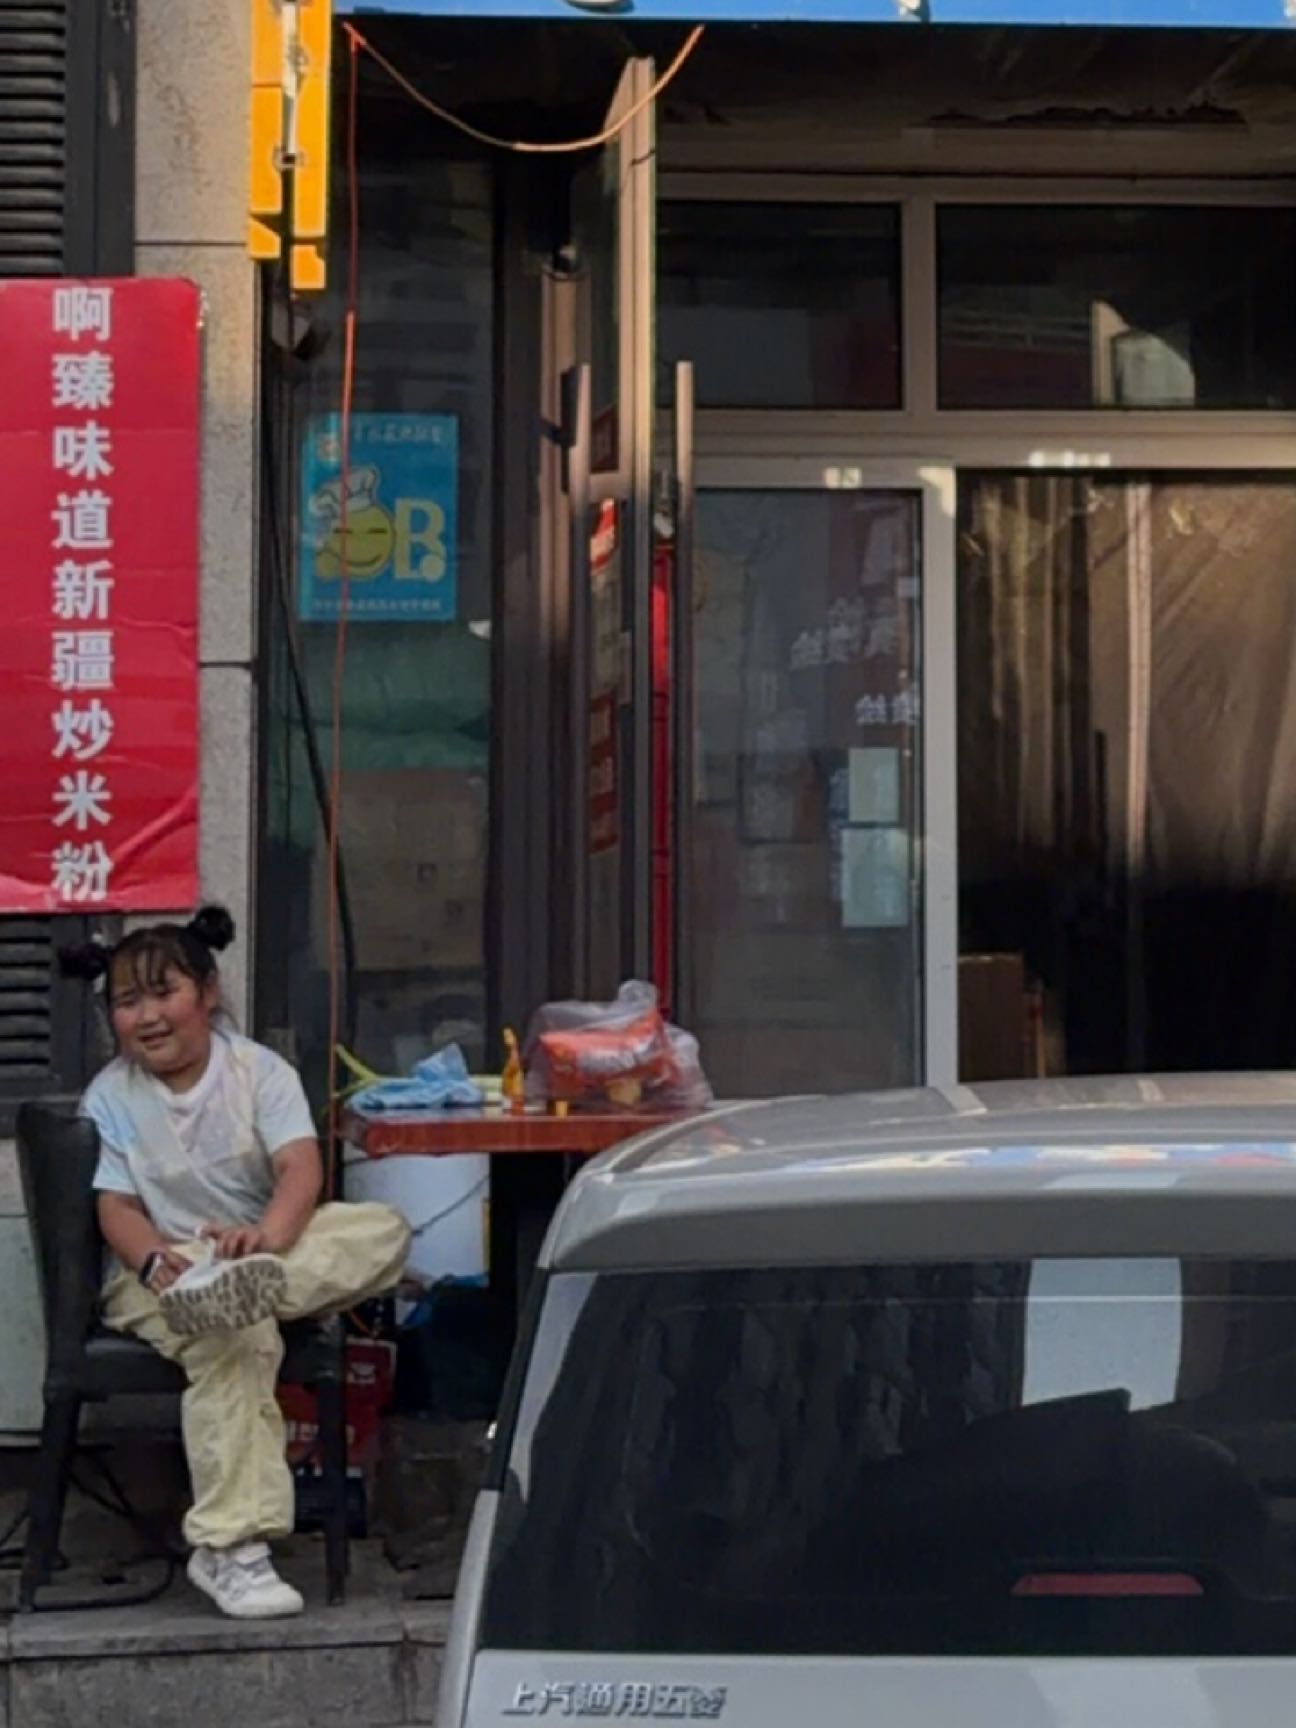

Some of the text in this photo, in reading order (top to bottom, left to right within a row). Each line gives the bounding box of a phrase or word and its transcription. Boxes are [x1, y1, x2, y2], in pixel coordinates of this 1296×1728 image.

[51, 287, 114, 903] 啊臻味道新疆炒米粉
[501, 1682, 727, 1718] 上汽通用五菱
